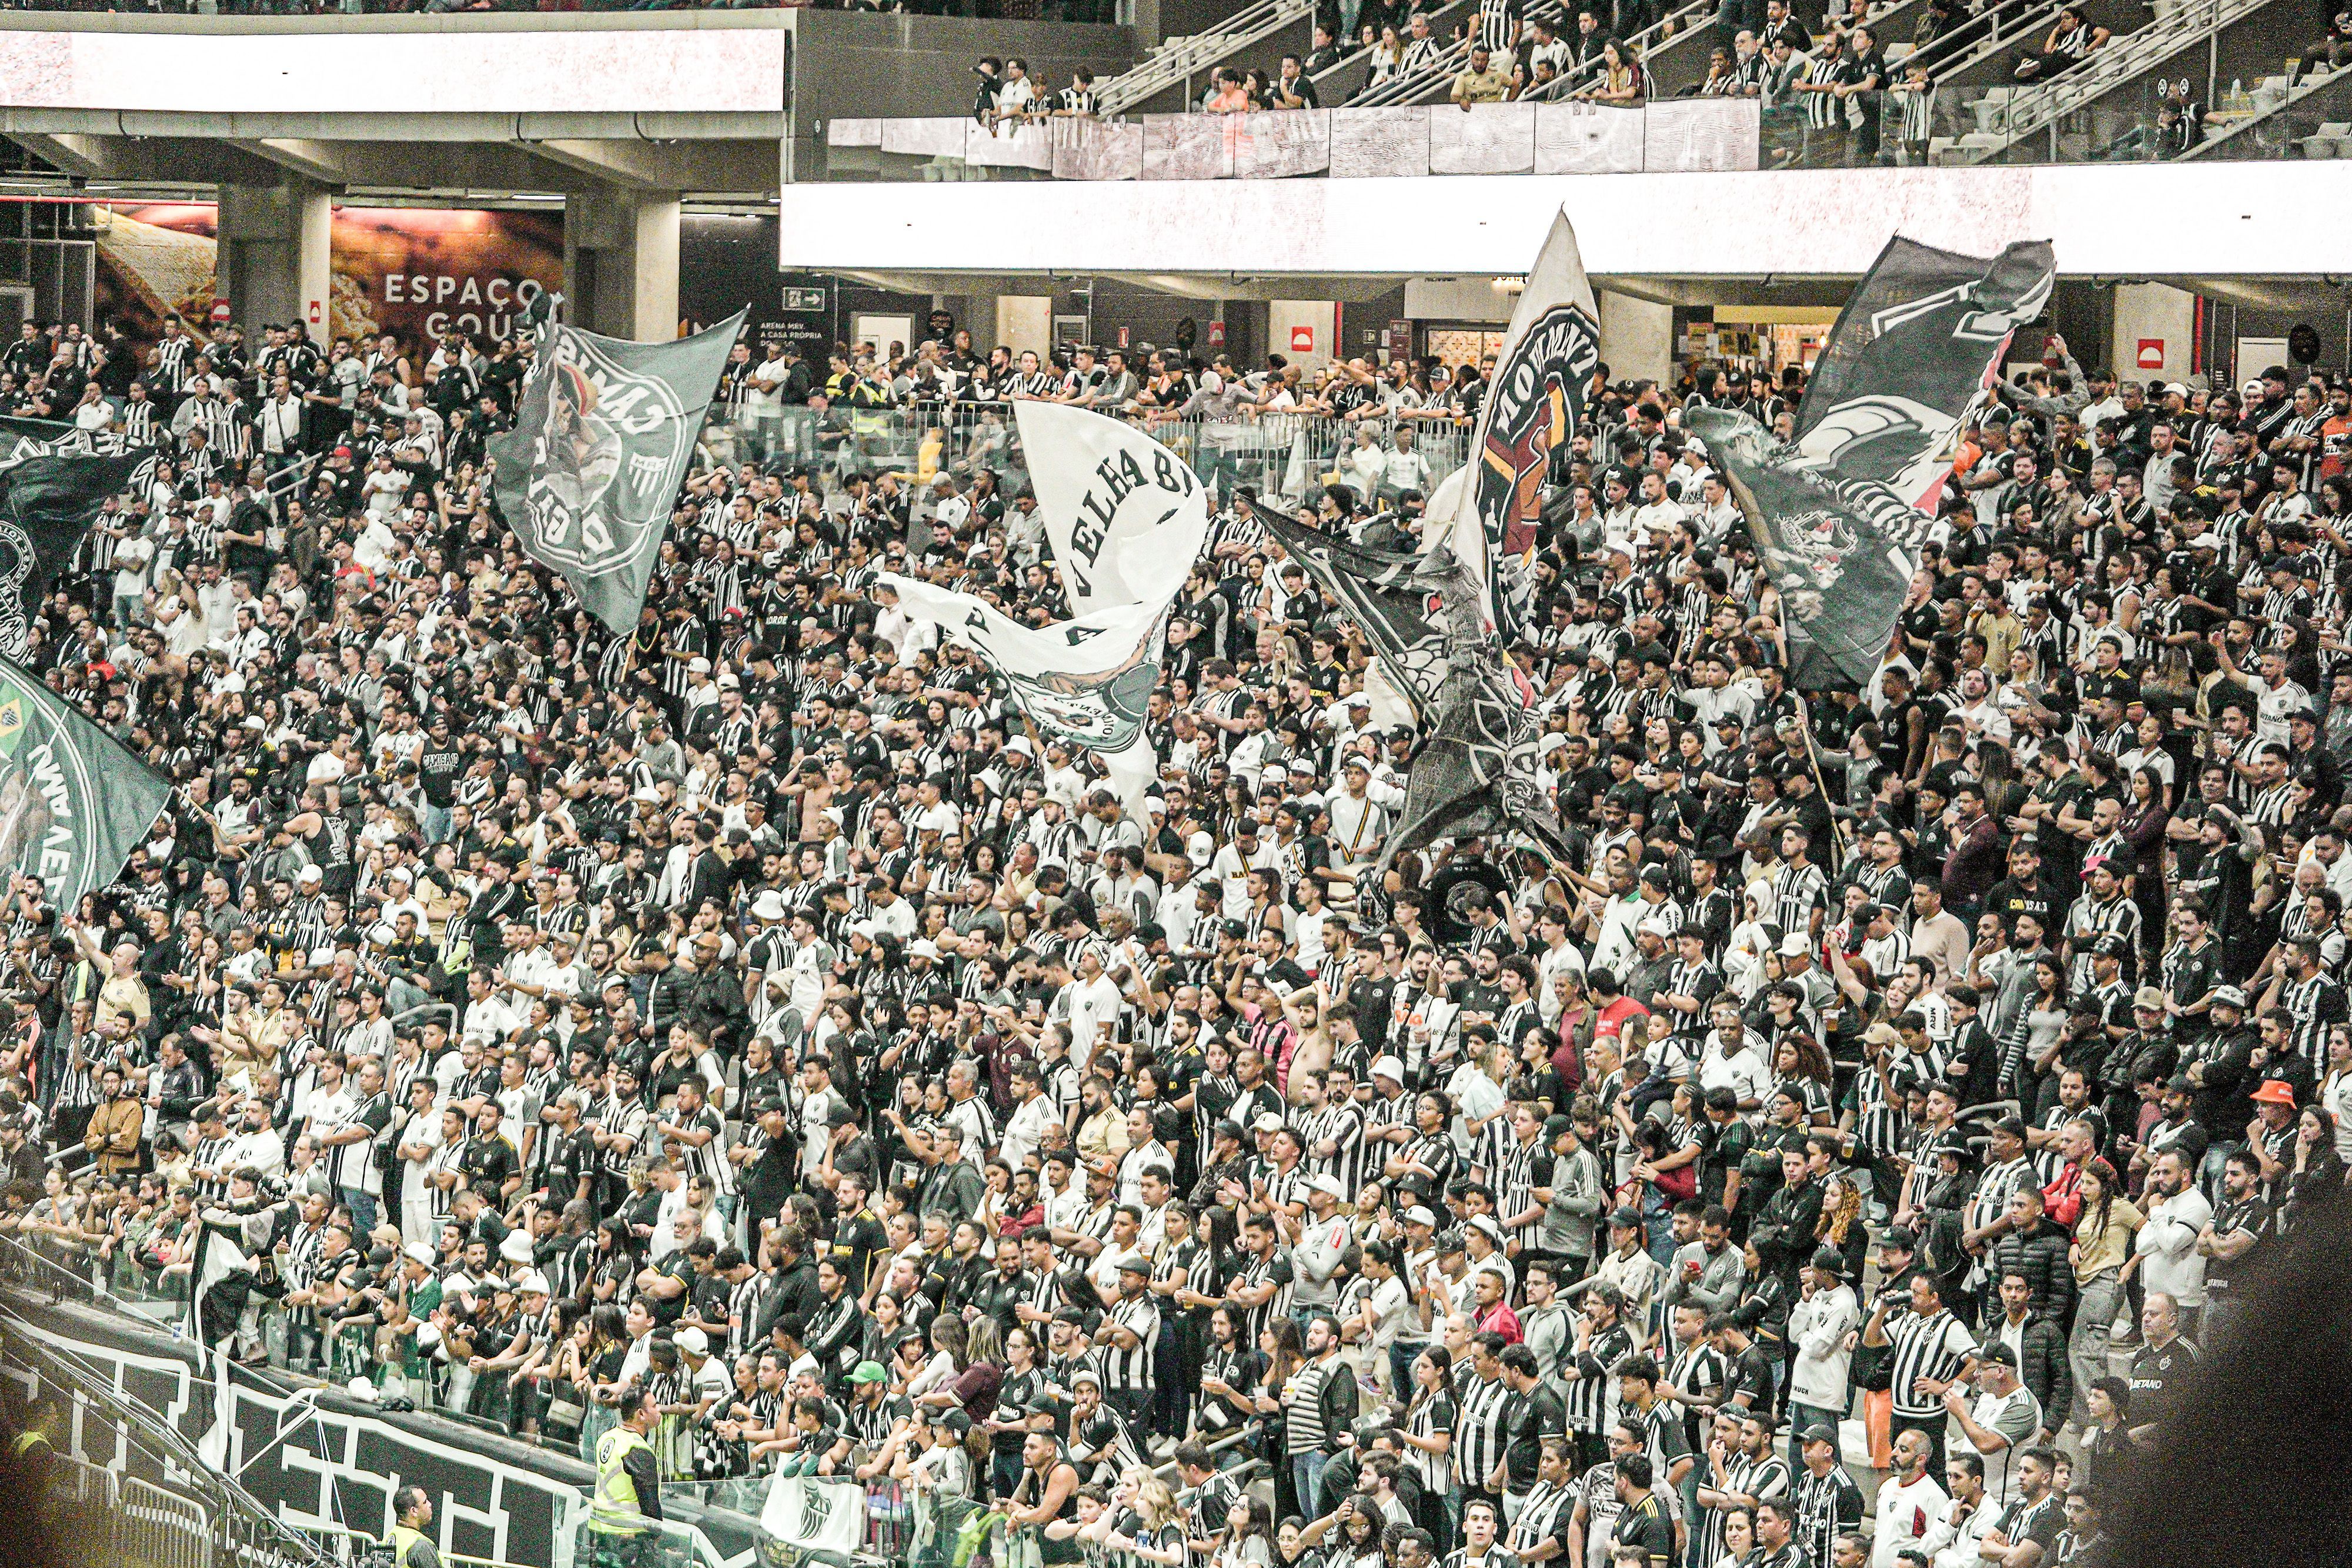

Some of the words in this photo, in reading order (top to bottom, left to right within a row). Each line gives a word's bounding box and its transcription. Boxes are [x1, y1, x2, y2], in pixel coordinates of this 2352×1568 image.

[386, 273, 543, 312] ESPAÇO
[789, 330, 823, 339] PRÓPRIA
[1464, 1412, 1485, 1426] BETANO
